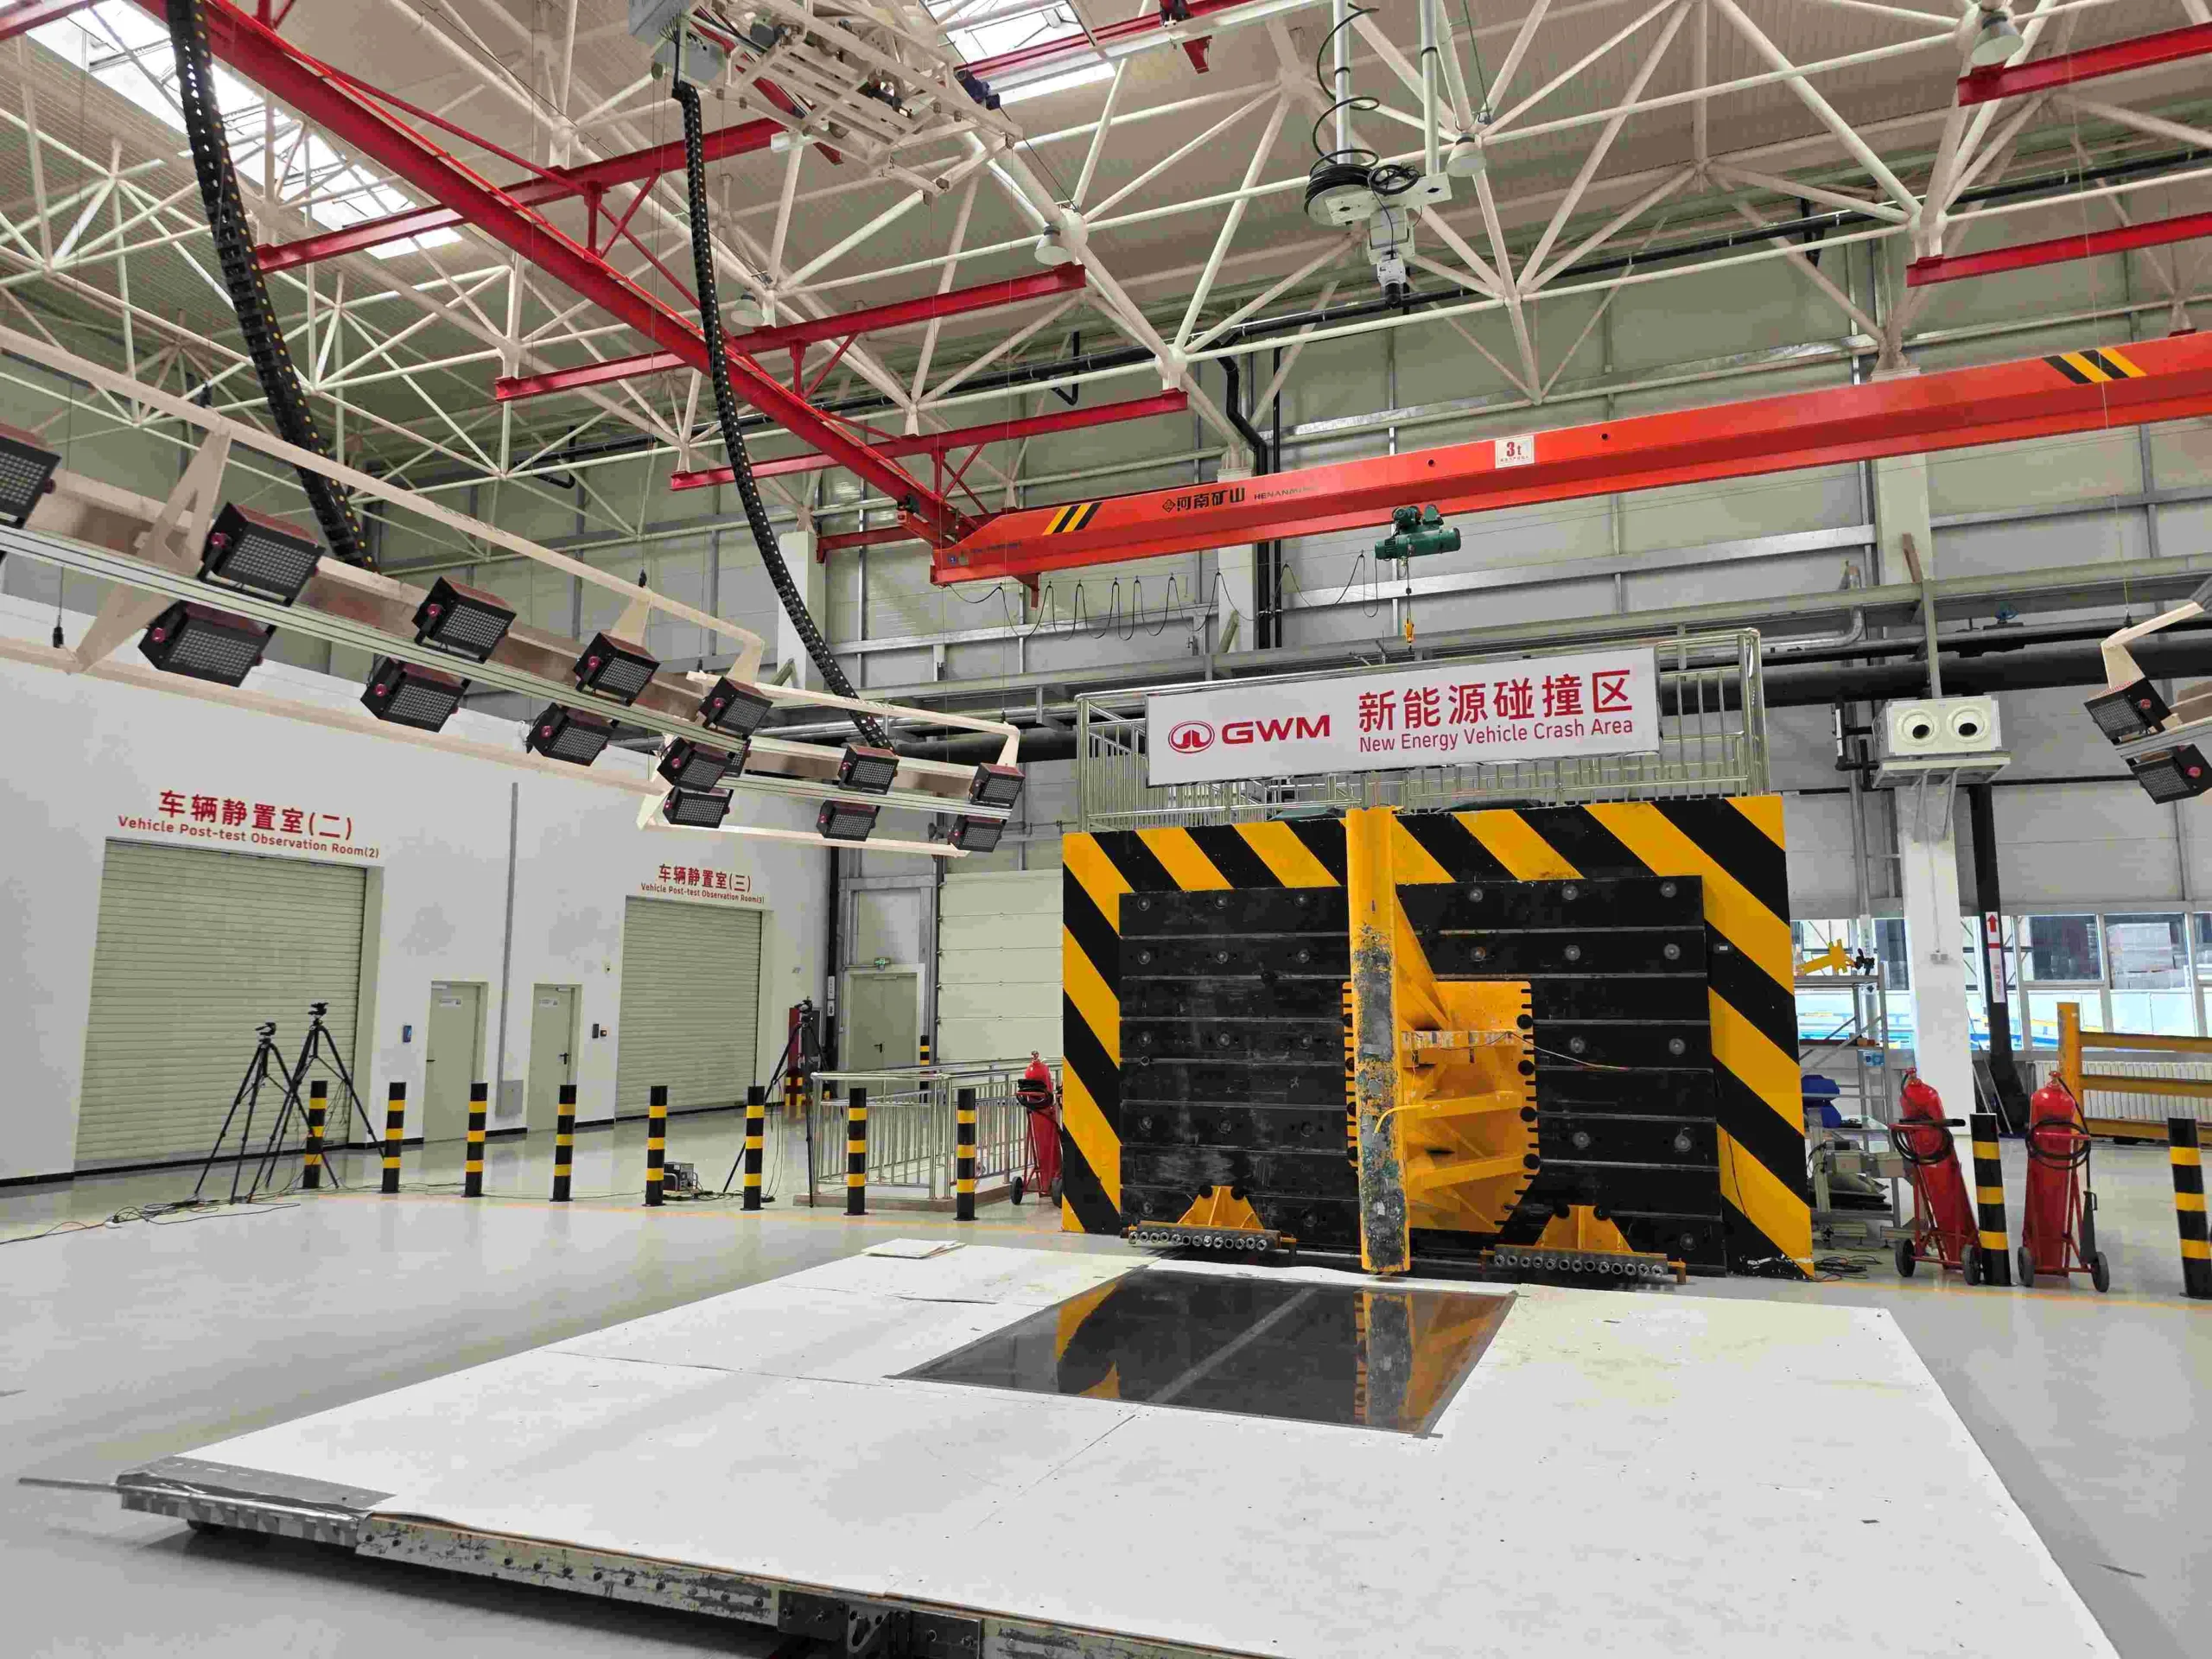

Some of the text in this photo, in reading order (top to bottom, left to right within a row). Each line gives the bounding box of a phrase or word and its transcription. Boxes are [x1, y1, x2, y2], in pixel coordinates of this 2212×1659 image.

[1506, 442, 1522, 457] 3t
[1176, 487, 1246, 512] 河南矿山
[1358, 669, 1633, 733] 新能源碰撞区
[1221, 715, 1331, 745] GWM
[1359, 718, 1633, 753] New Energy Vehicle Crash Area
[158, 790, 353, 841] 车辆静置室(二)
[118, 816, 379, 859] Vehicle Post-test Observation Room(2)
[641, 883, 666, 893] Vehicle
[668, 886, 700, 897] Post-test
[702, 890, 739, 901] Observation
[658, 863, 751, 893] 车辆静置室(三)
